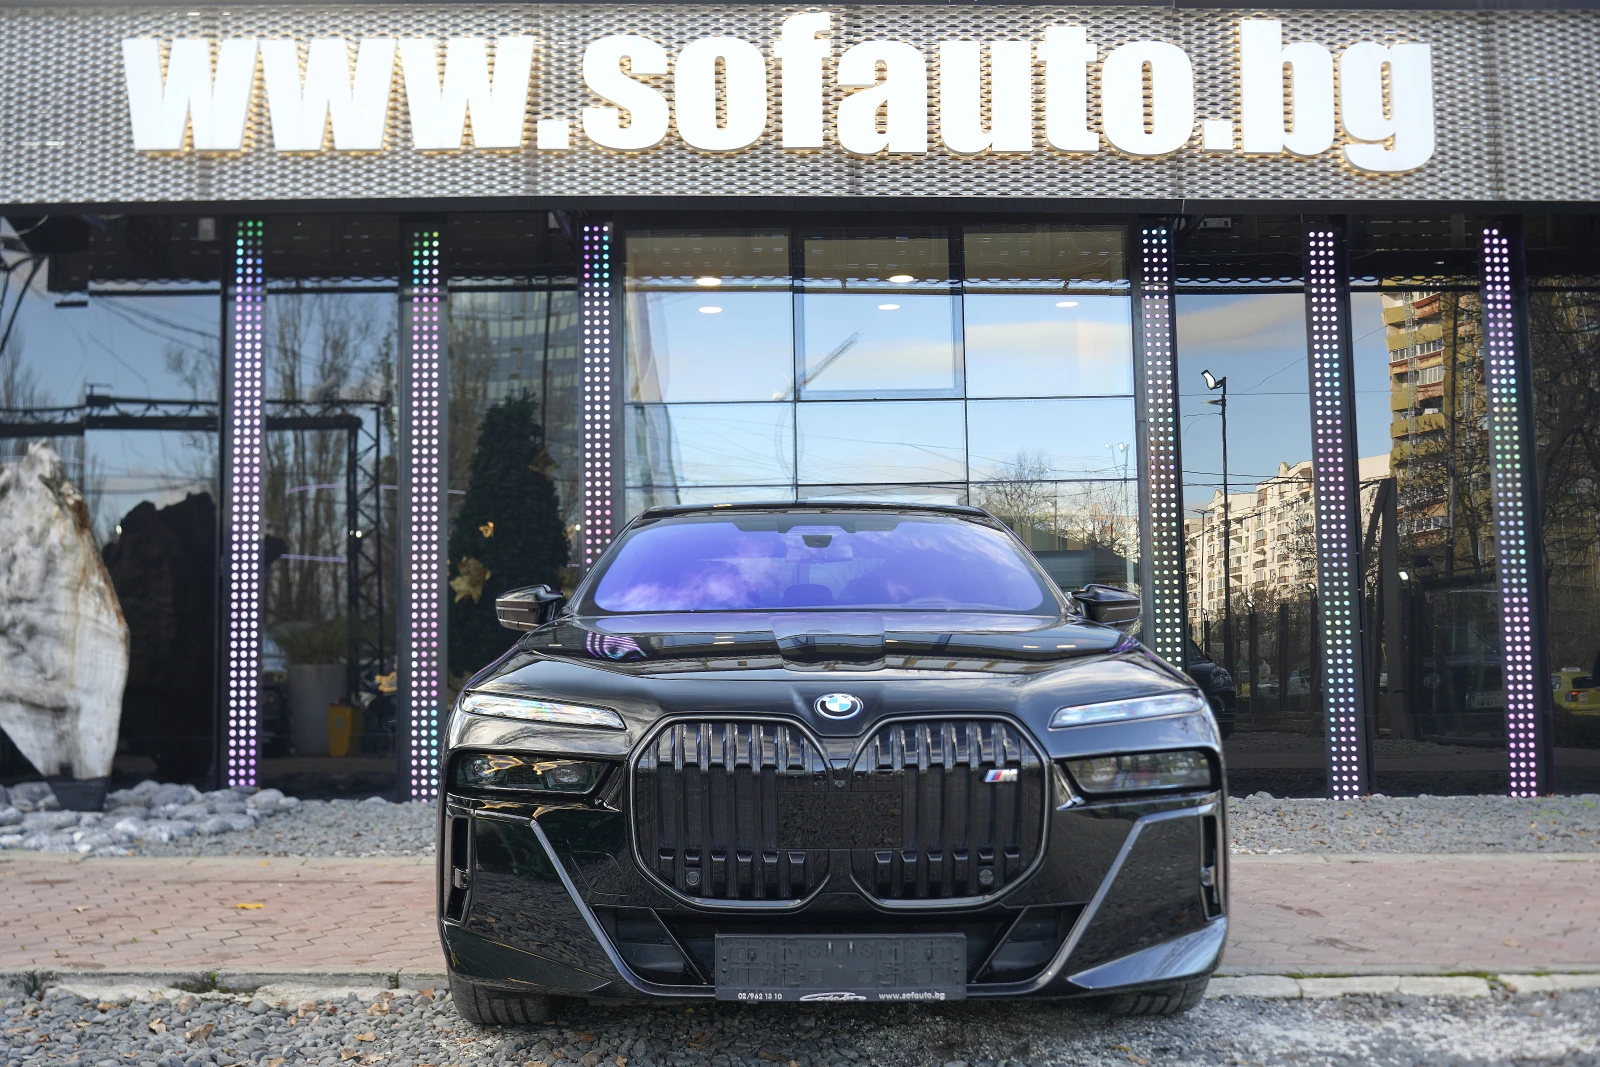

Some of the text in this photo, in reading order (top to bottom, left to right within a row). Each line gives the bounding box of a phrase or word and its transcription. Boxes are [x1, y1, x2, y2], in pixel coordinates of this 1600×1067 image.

[121, 11, 1436, 173] www.sofauto.bg
[737, 992, 783, 1000] 02/962 13 10
[878, 990, 946, 1001] www.sofauto.bg
